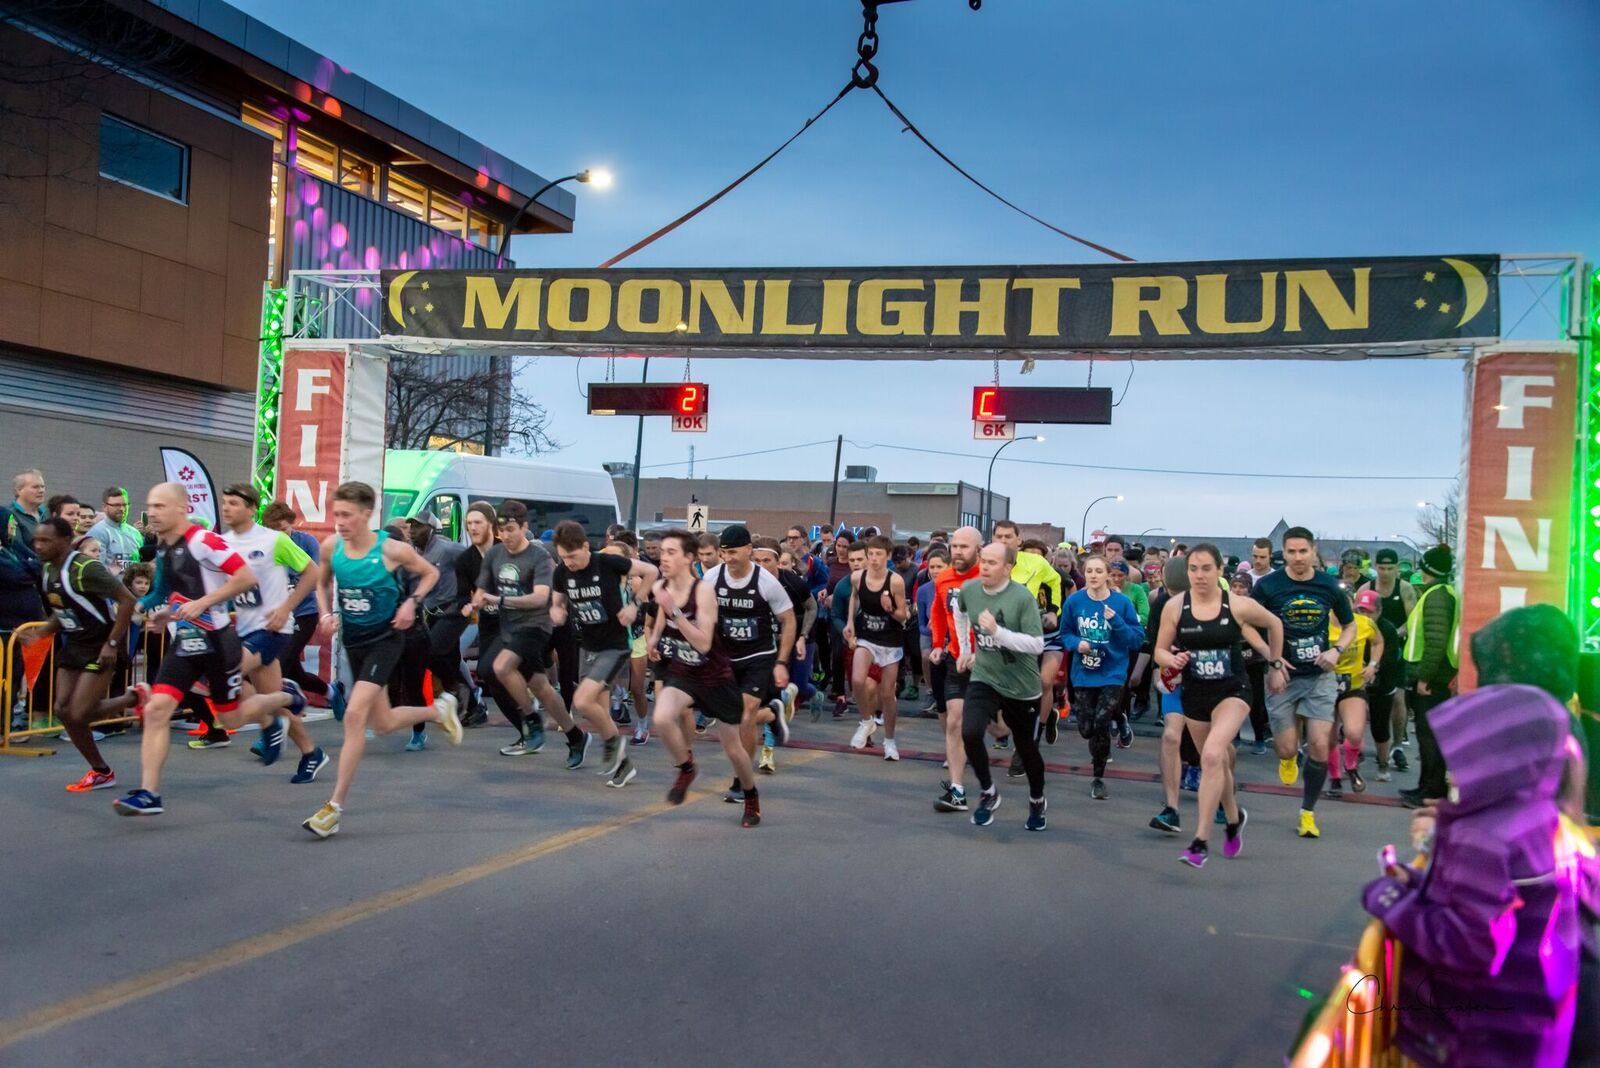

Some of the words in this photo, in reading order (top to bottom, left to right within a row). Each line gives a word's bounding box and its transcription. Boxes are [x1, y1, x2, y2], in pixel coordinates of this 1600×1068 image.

[461, 274, 1081, 336] MOONLIGHT
[1108, 267, 1373, 336] RUN
[682, 387, 697, 411] 2
[676, 416, 703, 428] 10K
[982, 424, 1006, 436] 6K
[580, 585, 602, 598] HARD
[732, 598, 754, 609] HARD
[729, 626, 752, 638] 241
[1296, 645, 1320, 660] 588
[1081, 654, 1101, 667] 352
[1195, 660, 1225, 675] 364
